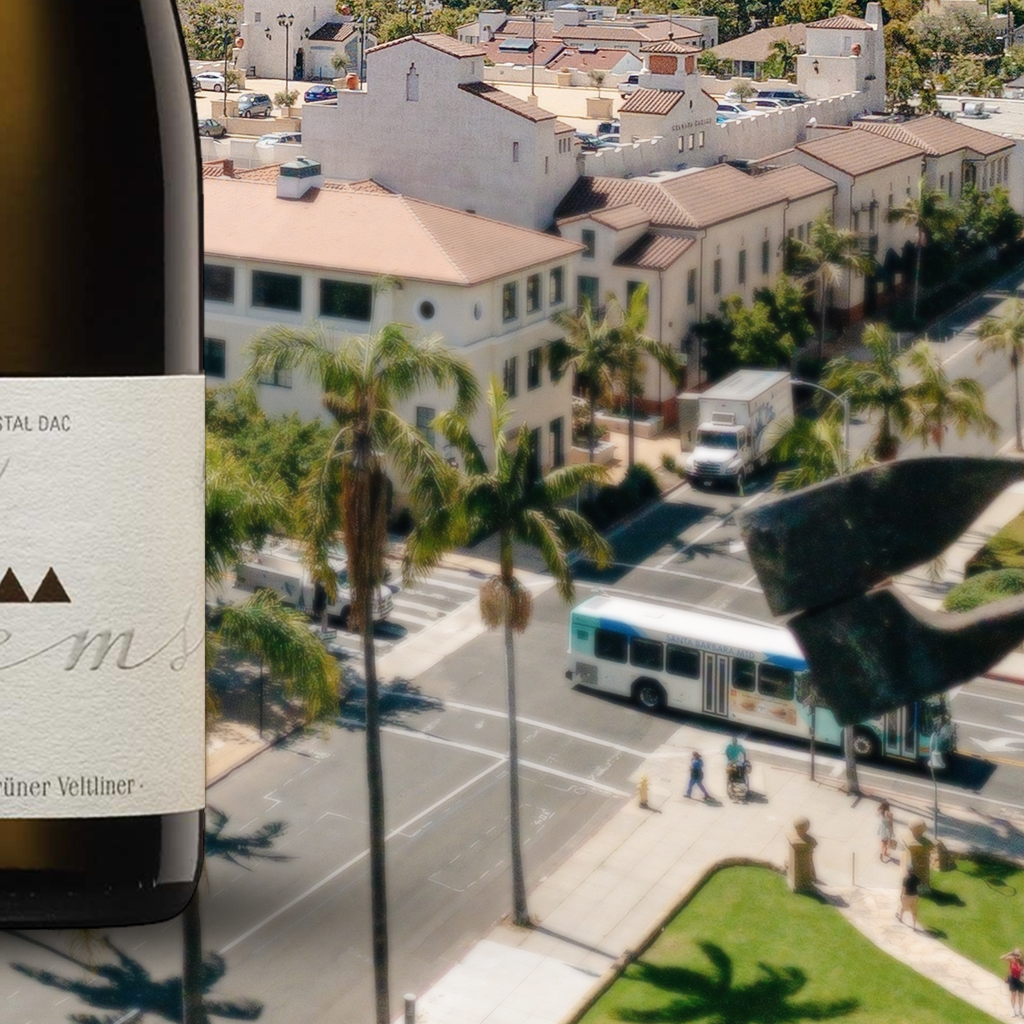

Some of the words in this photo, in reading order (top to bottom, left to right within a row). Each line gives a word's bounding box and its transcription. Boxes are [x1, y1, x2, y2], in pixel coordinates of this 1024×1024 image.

[38, 414, 71, 432] DAC
[666, 634, 693, 647] SANTA
[695, 641, 734, 654] BARBARA
[736, 649, 756, 660] MTD
[57, 775, 135, 797] Veltliner
